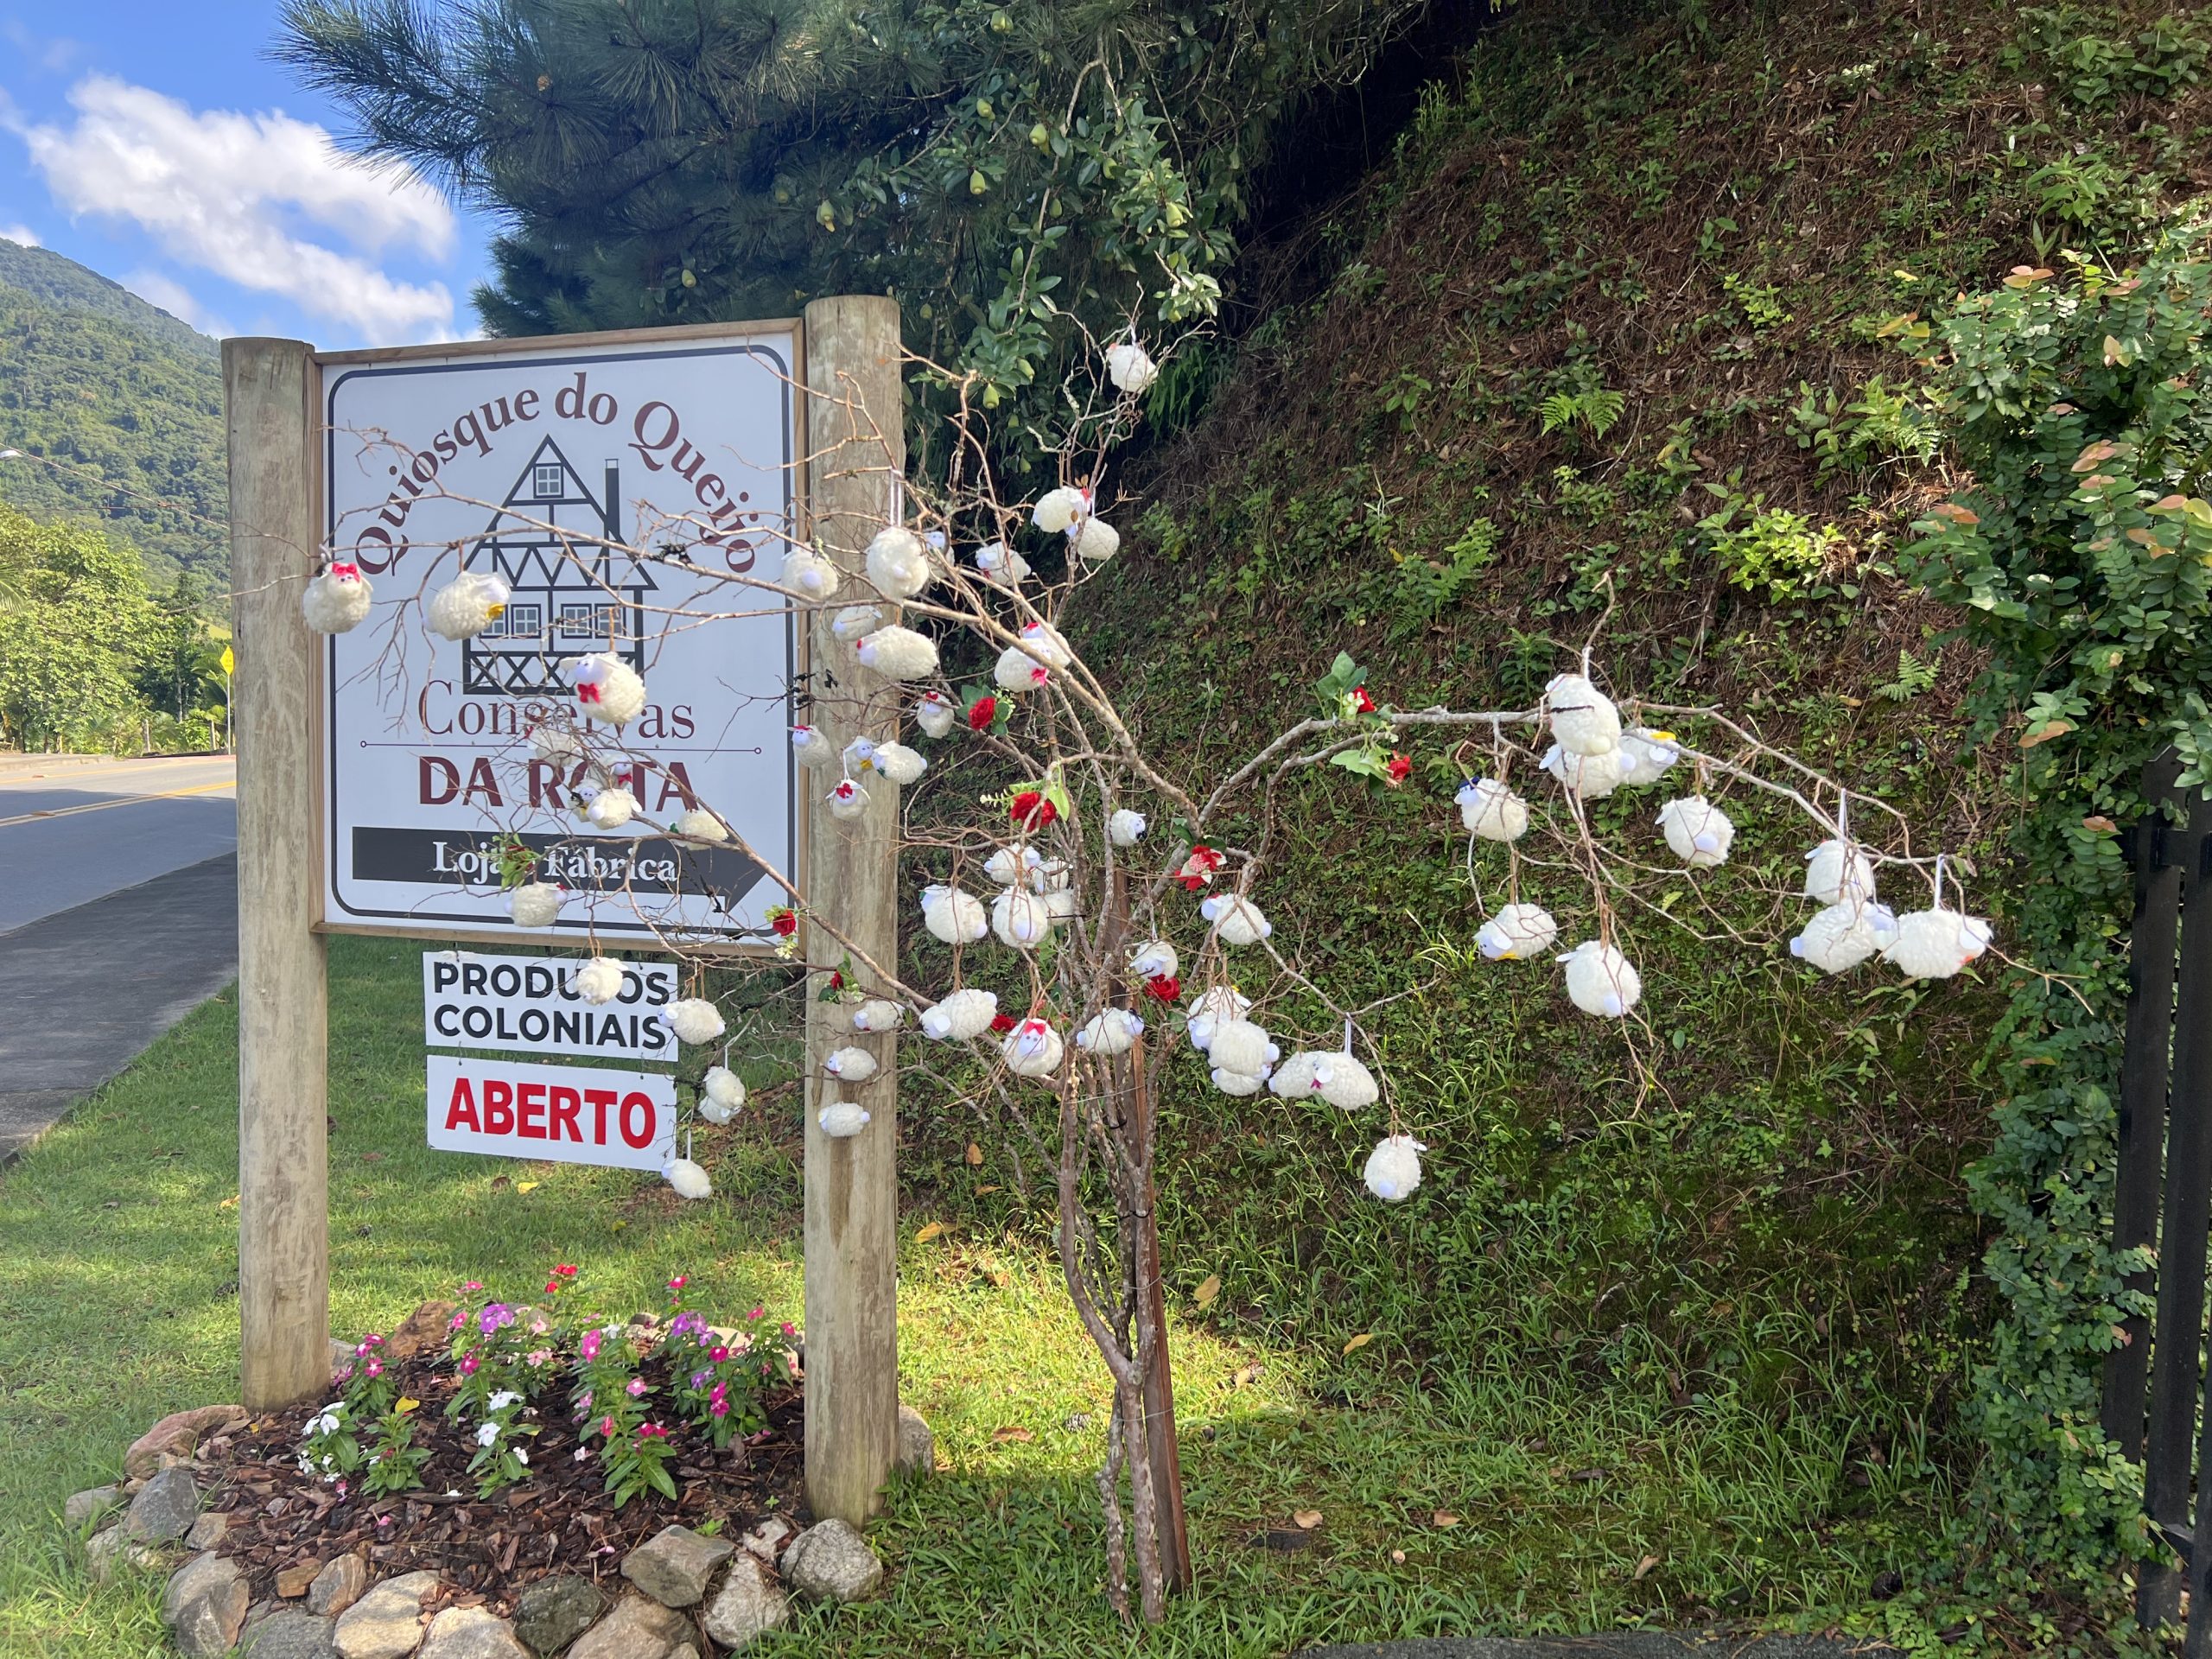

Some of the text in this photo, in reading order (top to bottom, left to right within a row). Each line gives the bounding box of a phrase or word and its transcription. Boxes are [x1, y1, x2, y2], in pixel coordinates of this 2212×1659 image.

[356, 372, 760, 575] Quiosque do Queijo
[418, 680, 696, 739] Conseas
[419, 756, 503, 806] DA
[543, 846, 677, 882] Fábrica
[434, 962, 670, 1006] PRODUOS
[434, 1004, 666, 1050] COLONIAIS
[445, 1077, 657, 1149] ABERTO
